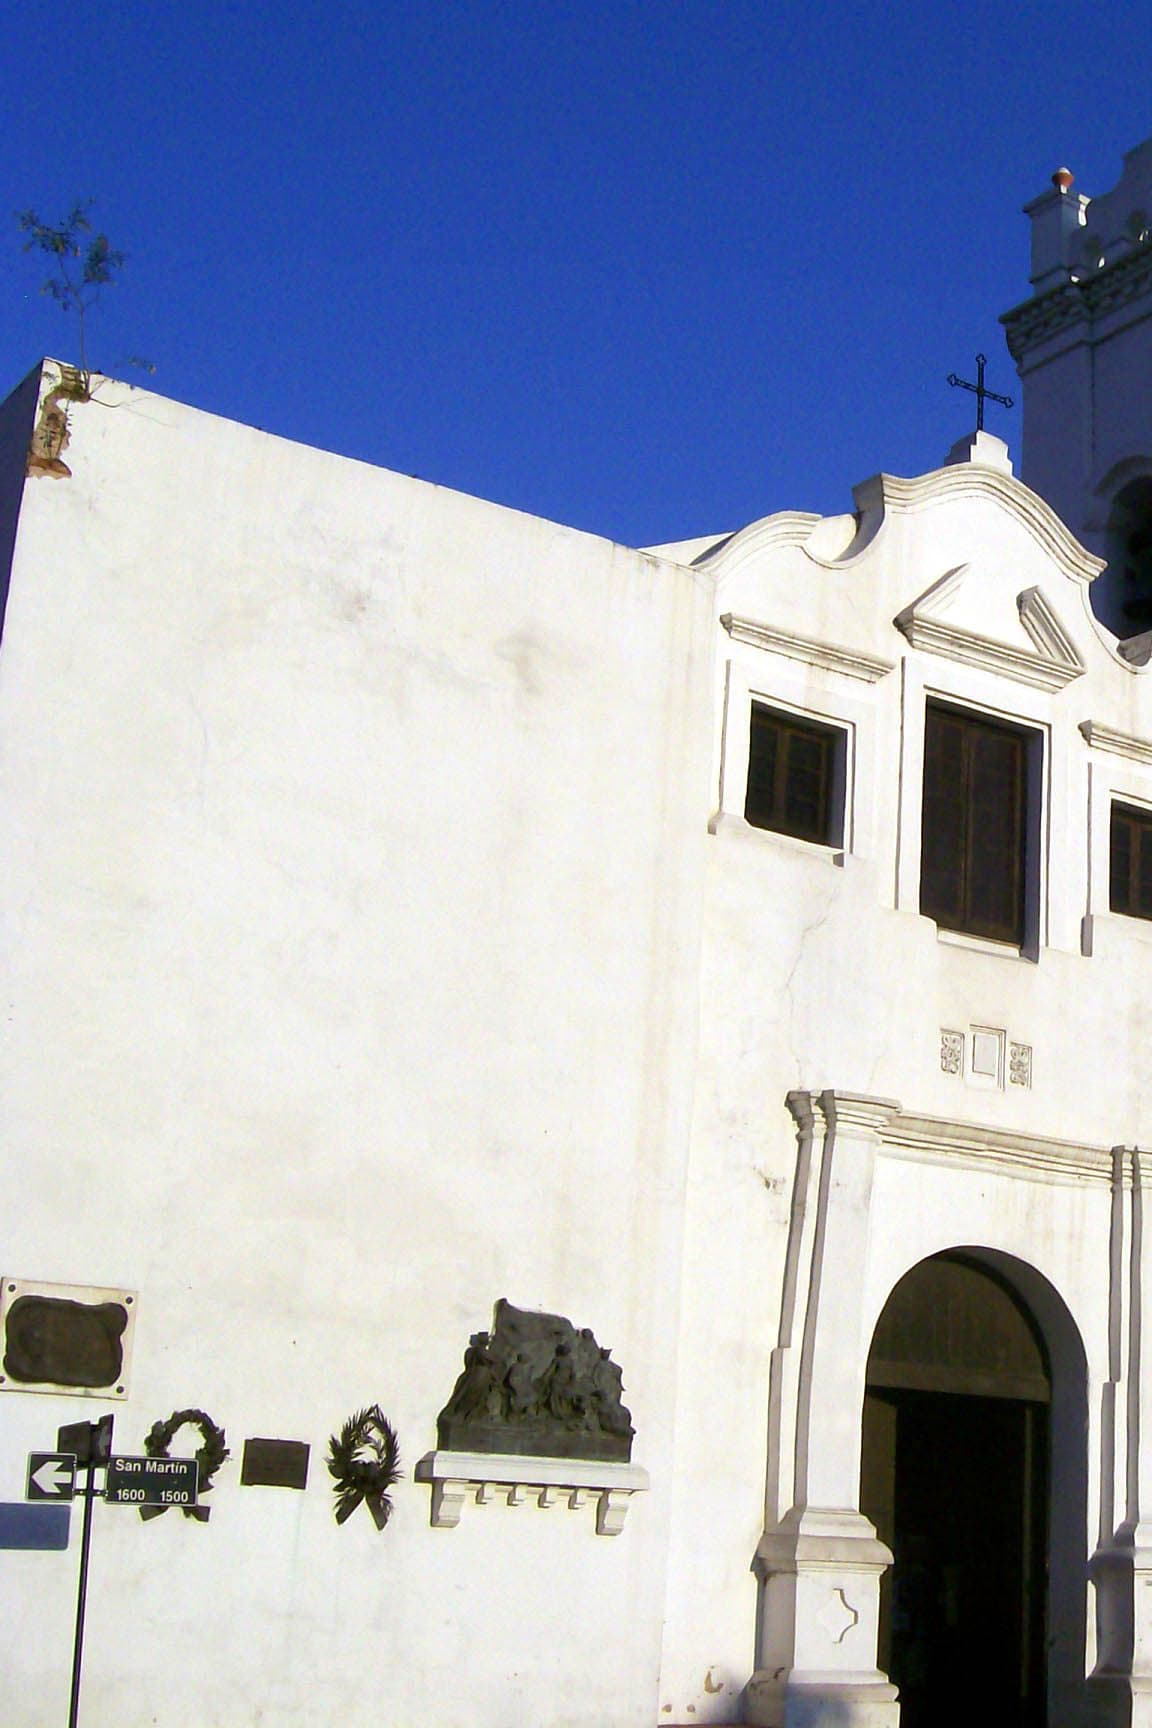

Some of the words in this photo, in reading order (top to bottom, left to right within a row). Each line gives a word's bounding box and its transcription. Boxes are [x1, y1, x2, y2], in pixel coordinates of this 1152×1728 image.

[115, 1459, 141, 1472] San
[116, 1488, 145, 1501] 1600
[160, 1490, 189, 1503] 1500
